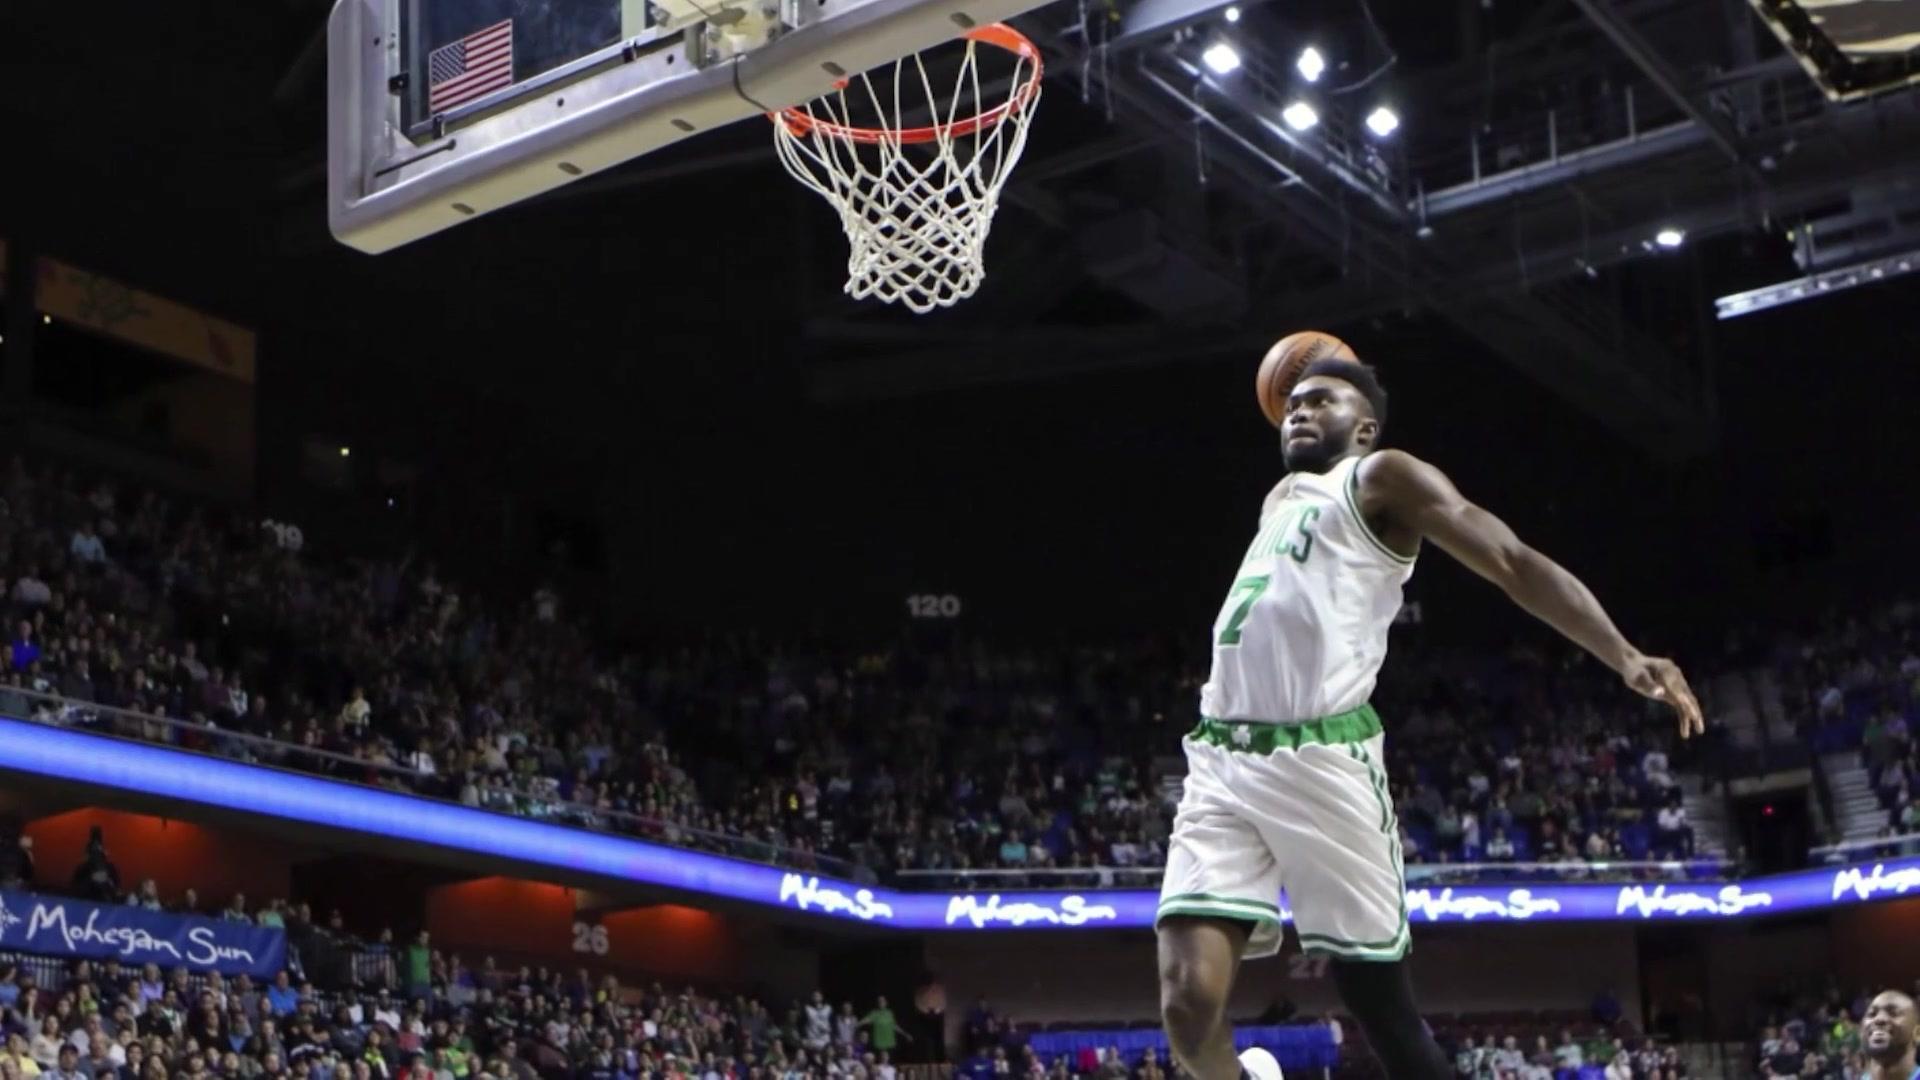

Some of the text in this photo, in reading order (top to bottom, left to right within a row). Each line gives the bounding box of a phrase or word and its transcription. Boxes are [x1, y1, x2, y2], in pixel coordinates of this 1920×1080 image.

[261, 518, 304, 551] 19
[906, 595, 961, 617] 120
[1218, 574, 1271, 646] 7
[26, 903, 254, 964] Mohegan Sun
[572, 921, 609, 955] 26
[1288, 953, 1329, 979] 27
